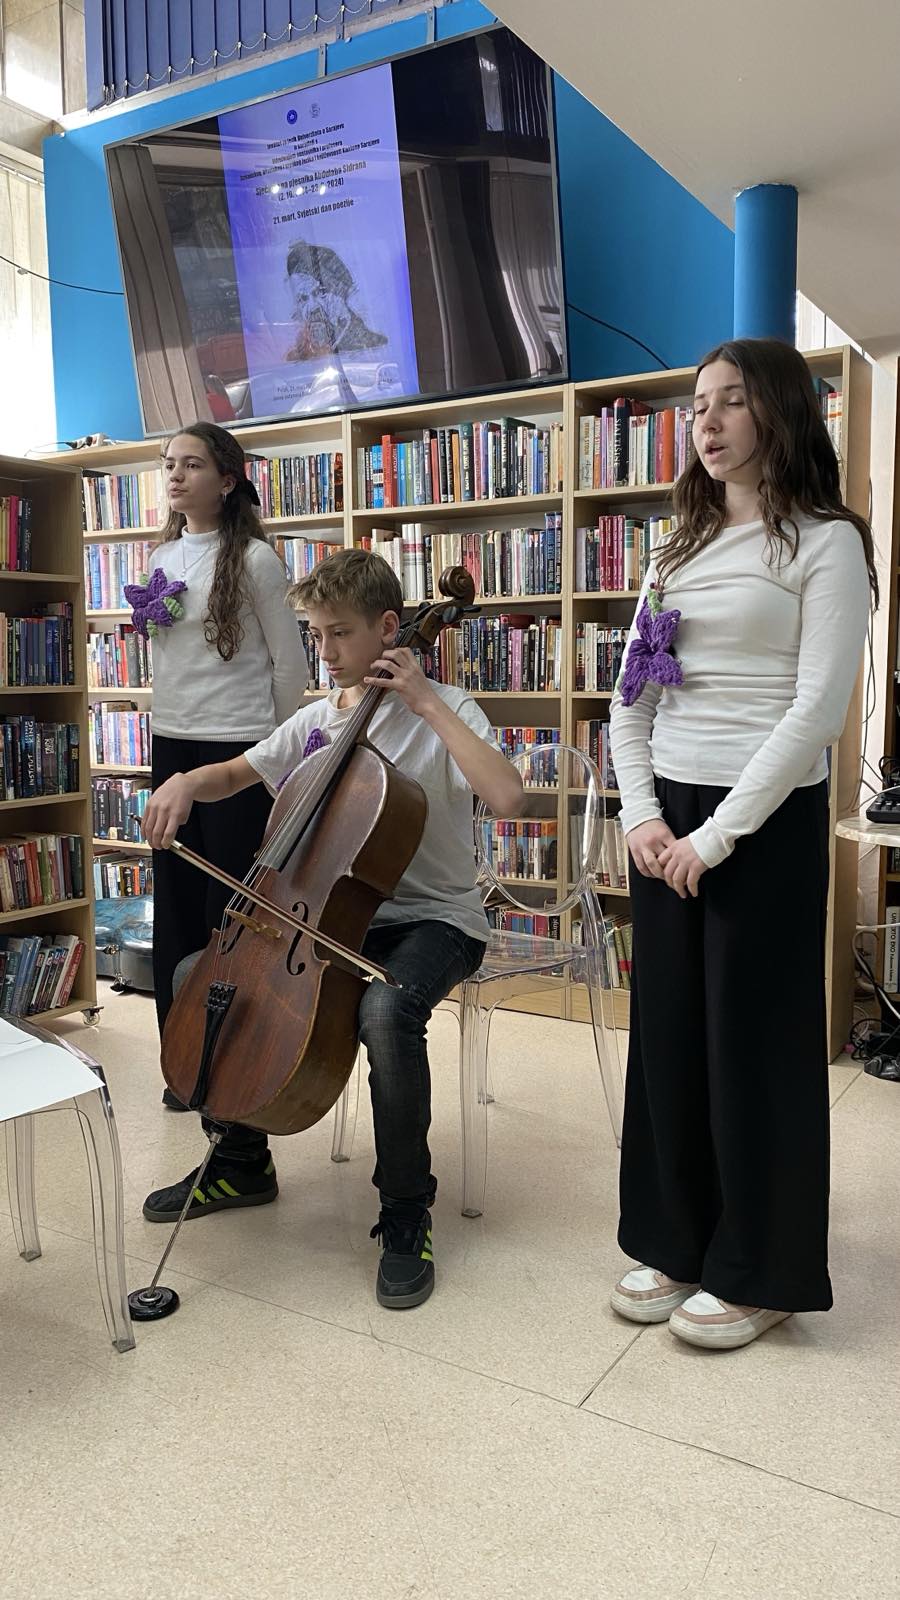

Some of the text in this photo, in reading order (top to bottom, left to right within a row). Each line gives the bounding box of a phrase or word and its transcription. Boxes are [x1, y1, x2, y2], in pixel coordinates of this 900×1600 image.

[342, 161, 367, 174] Sidrana
[273, 216, 281, 225] 21.
[296, 206, 320, 219] Svjetski
[320, 204, 333, 213] dan
[332, 198, 354, 211] poezije
